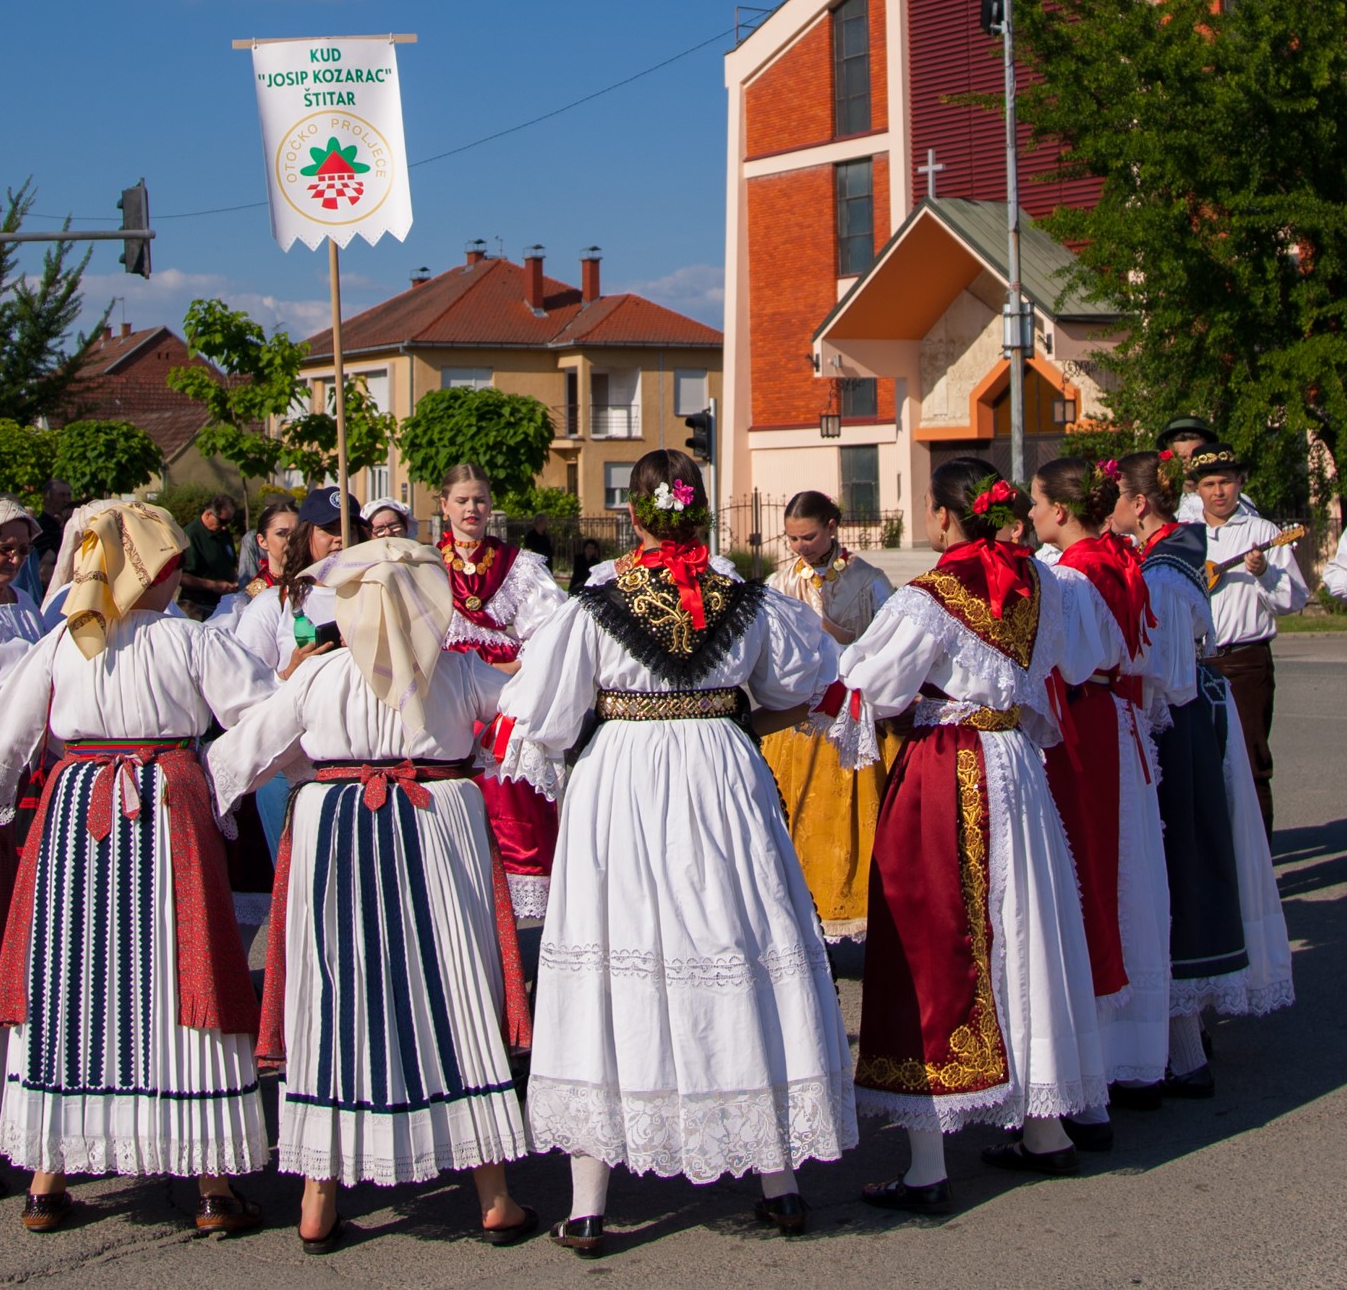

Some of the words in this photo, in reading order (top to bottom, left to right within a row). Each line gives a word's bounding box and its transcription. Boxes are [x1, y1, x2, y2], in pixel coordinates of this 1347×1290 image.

[310, 48, 341, 63] KUD
[258, 71, 309, 88] "JOSIP
[313, 68, 392, 84] KOZARAC"
[303, 87, 356, 107] ŠTITAR
[285, 124, 318, 183] OTOČKO
